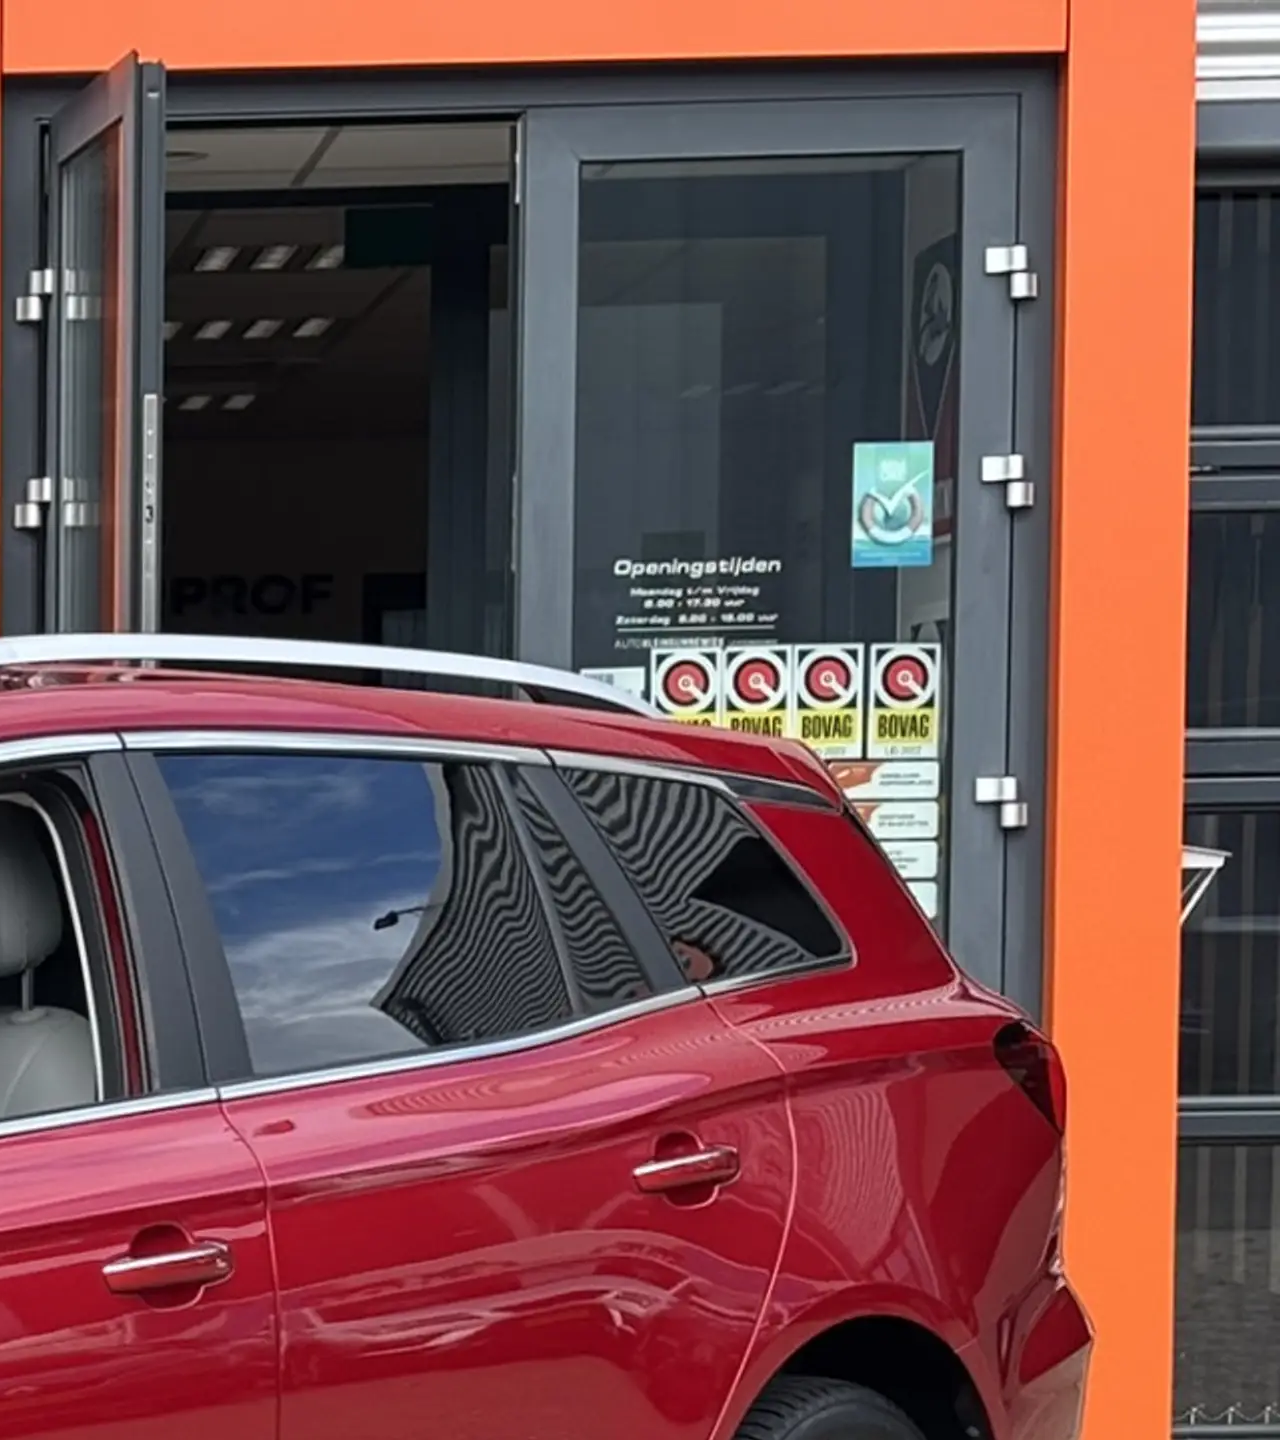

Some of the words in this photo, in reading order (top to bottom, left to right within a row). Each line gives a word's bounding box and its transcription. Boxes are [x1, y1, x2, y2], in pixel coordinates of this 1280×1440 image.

[613, 556, 782, 578] Openingstijden
[630, 587, 683, 598] Maandag
[716, 584, 760, 597] Vrijdag
[615, 614, 671, 626] Zaterdag
[801, 715, 853, 738] BOVAG
[878, 714, 929, 738] BOVAG
